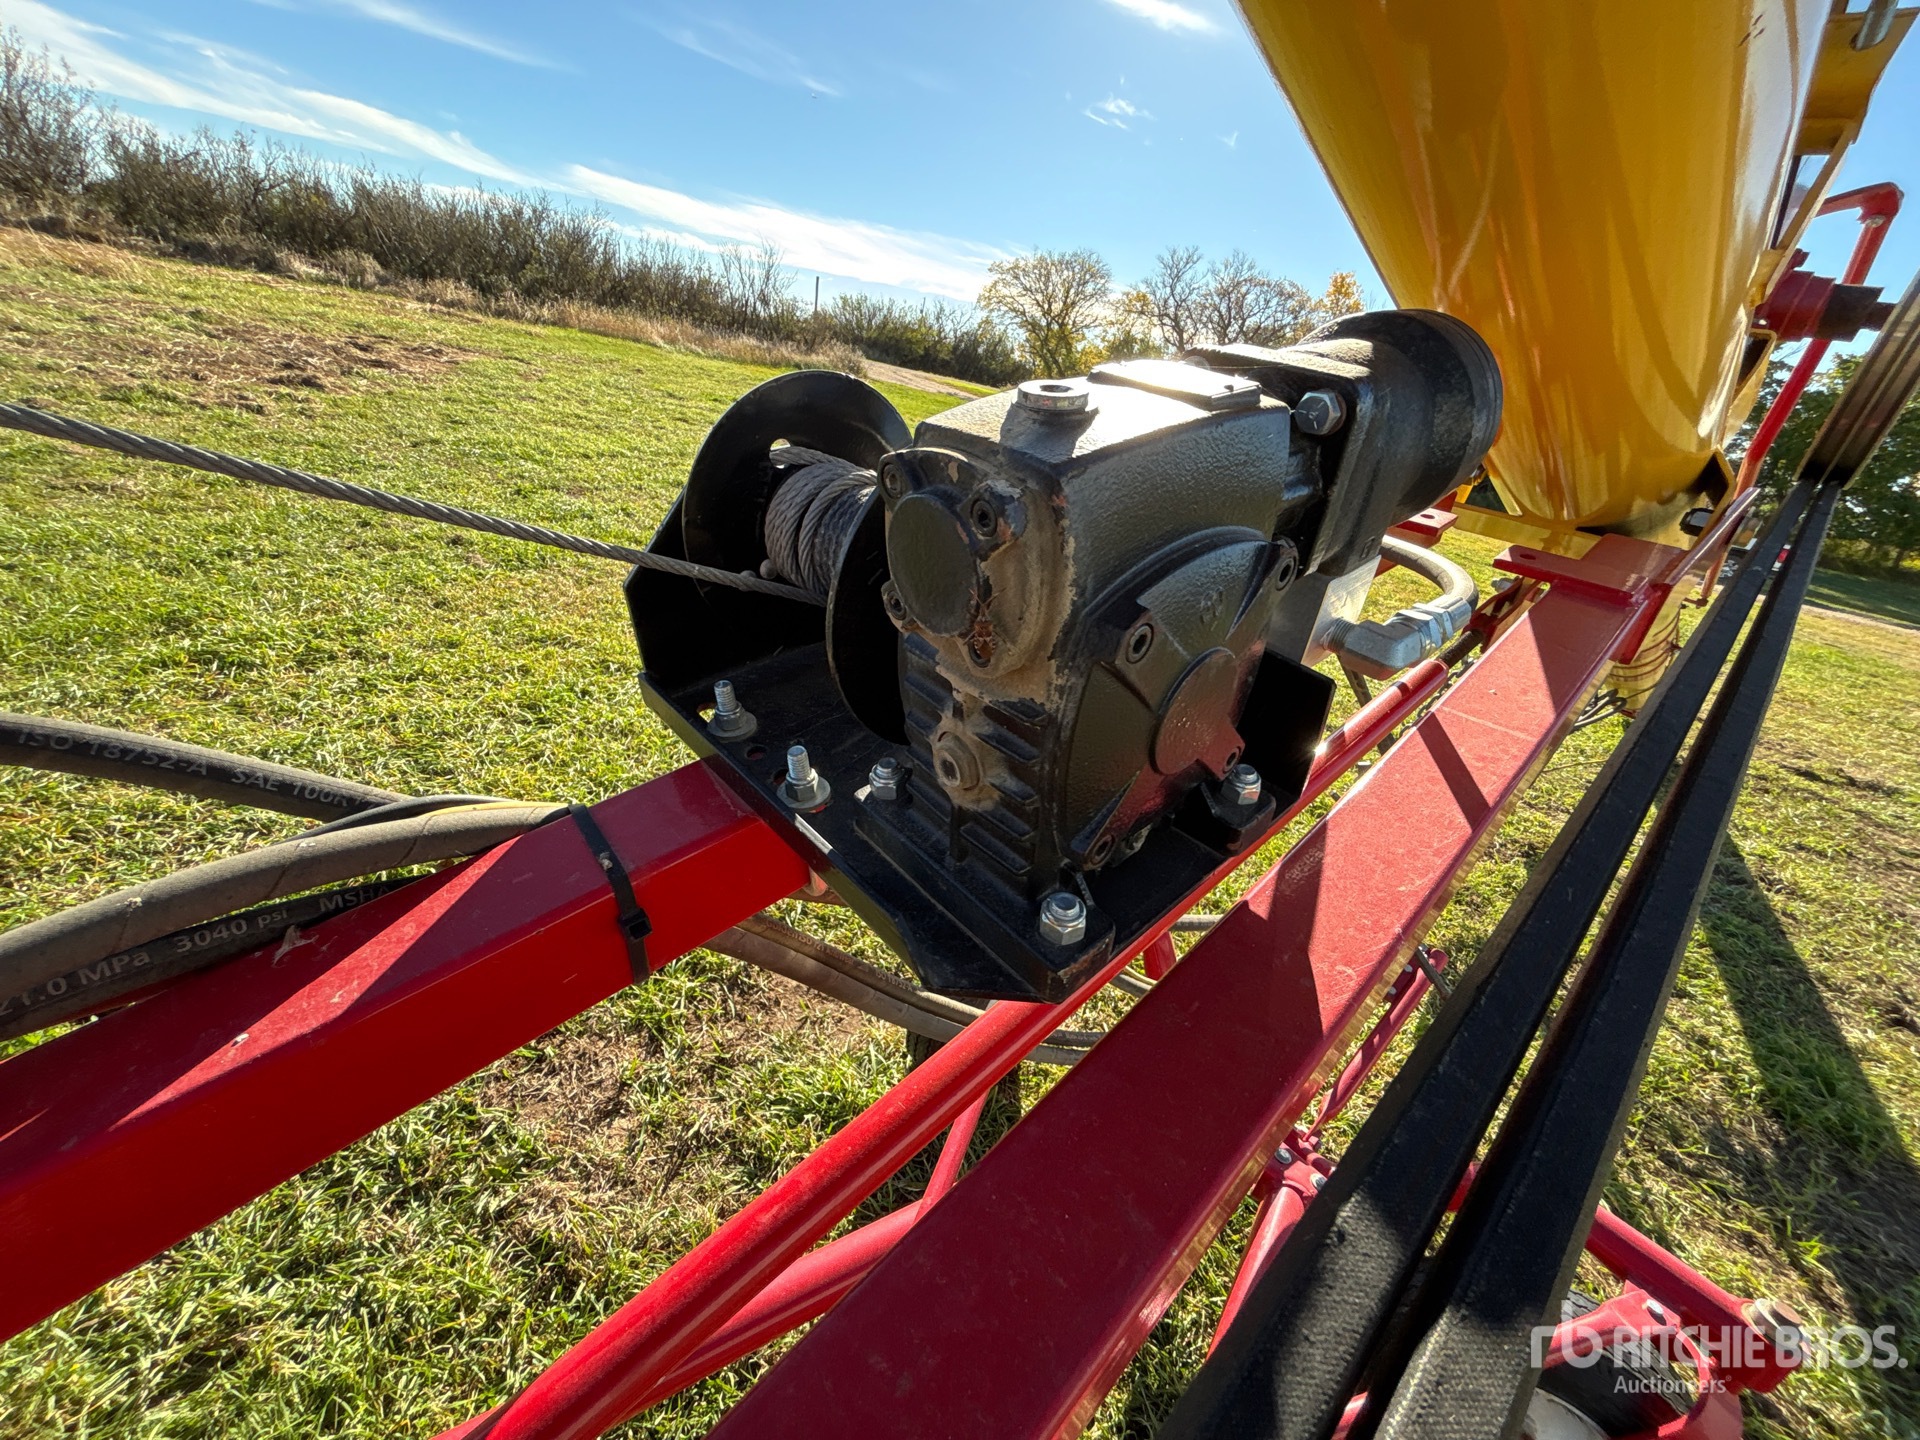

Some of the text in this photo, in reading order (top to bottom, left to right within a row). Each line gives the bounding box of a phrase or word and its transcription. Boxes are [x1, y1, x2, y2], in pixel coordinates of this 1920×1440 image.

[18, 729, 73, 750] ISO
[90, 739, 207, 776] 18752-A
[231, 768, 283, 792] SAE
[77, 951, 151, 985] MPa
[176, 919, 248, 953] 3040
[257, 908, 288, 929] psi
[319, 884, 390, 913] MSHA
